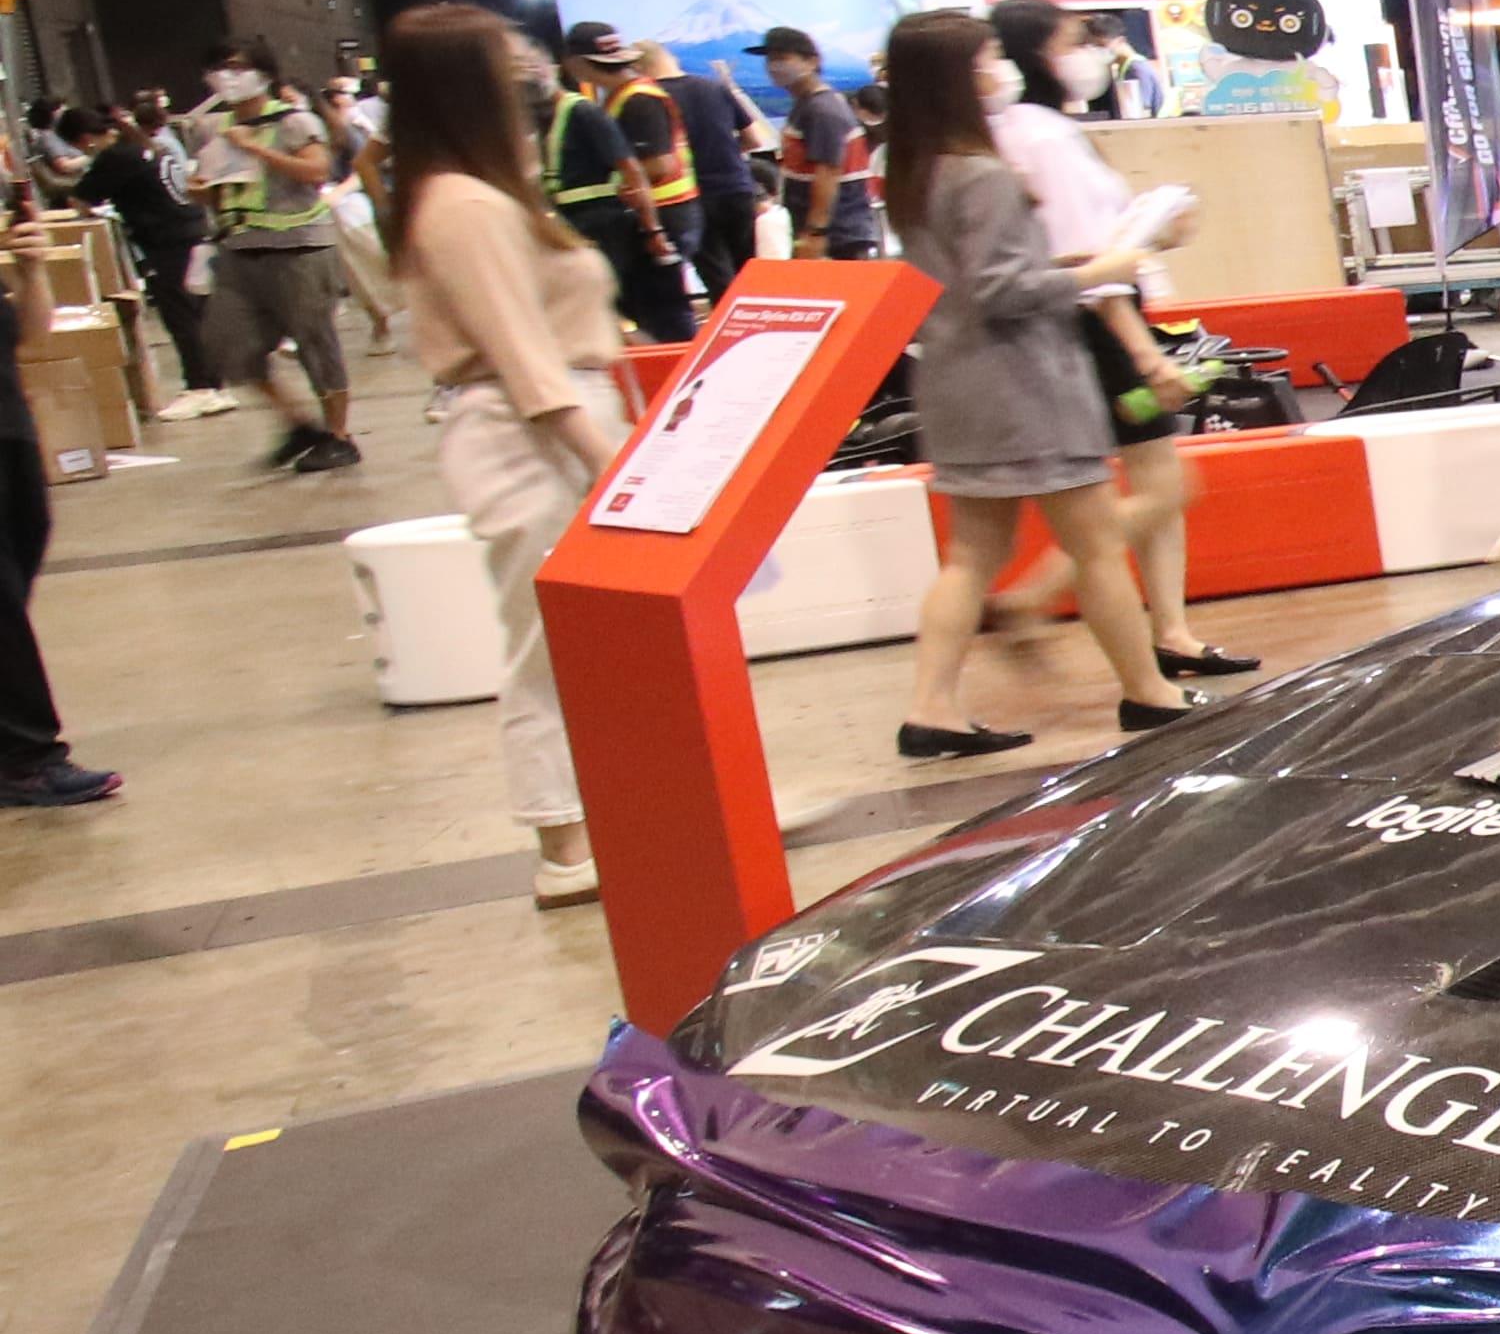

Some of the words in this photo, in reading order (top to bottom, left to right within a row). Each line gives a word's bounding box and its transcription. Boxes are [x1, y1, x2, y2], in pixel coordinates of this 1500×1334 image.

[916, 1081, 1121, 1135] VIRTUAL
[1147, 1120, 1213, 1153] TO
[1274, 1147, 1492, 1221] EALITY
